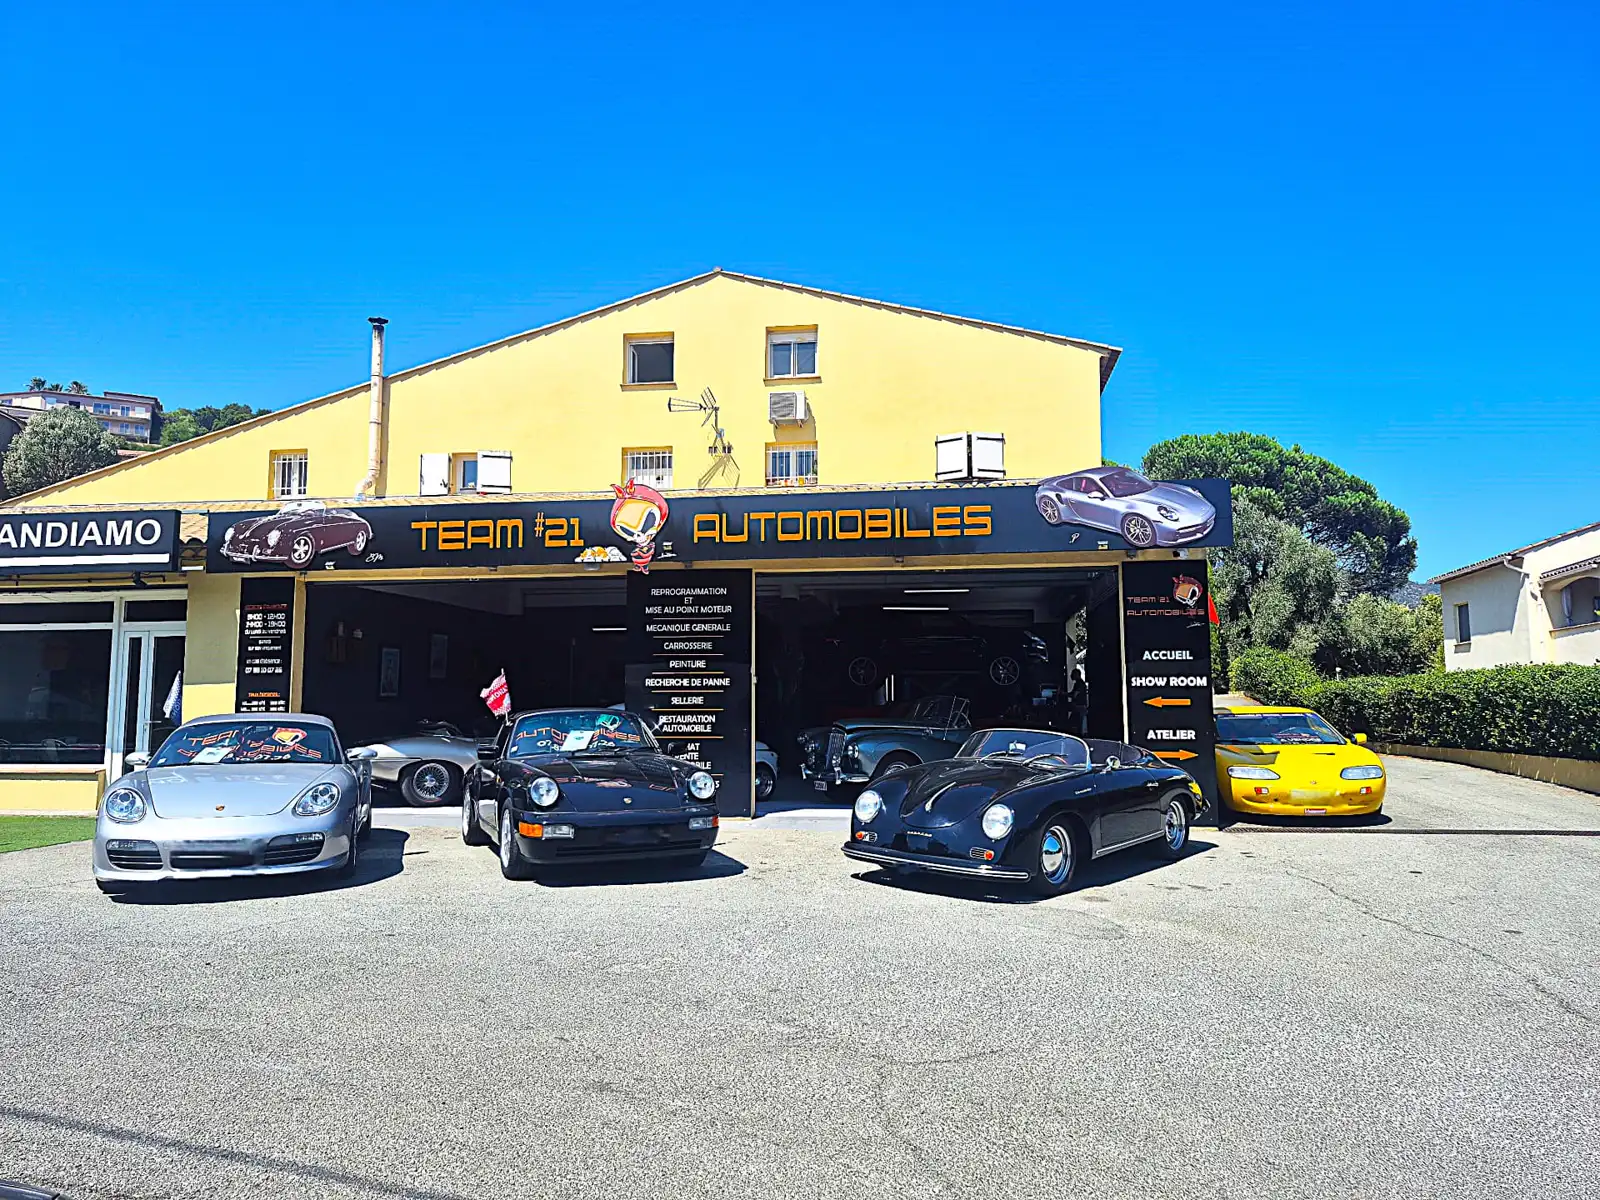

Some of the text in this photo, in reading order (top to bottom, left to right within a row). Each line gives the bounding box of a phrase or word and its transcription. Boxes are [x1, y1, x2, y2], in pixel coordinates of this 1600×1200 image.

[693, 505, 992, 544] AUTOMOBILES
[0, 519, 161, 548] ANDIAMO
[411, 512, 584, 550] TEAM #21
[645, 606, 662, 614] MISE
[700, 605, 732, 613] MOTEUR
[1127, 608, 1205, 616] AUTOMOBILES
[646, 623, 731, 632] MECANIQUE GENERALE
[663, 642, 712, 650] CARROSSERIE
[1143, 650, 1193, 660] ACCUEIL
[669, 660, 706, 668] PEINTURE
[645, 677, 731, 687] RECHERCHE DE PANNE
[1131, 676, 1208, 687] SHOW ROOM
[671, 696, 704, 705] SELLERIE
[659, 715, 716, 723] RESTAURATION
[662, 724, 712, 732] AUTOMOBILE
[1147, 729, 1196, 740] ATELIER
